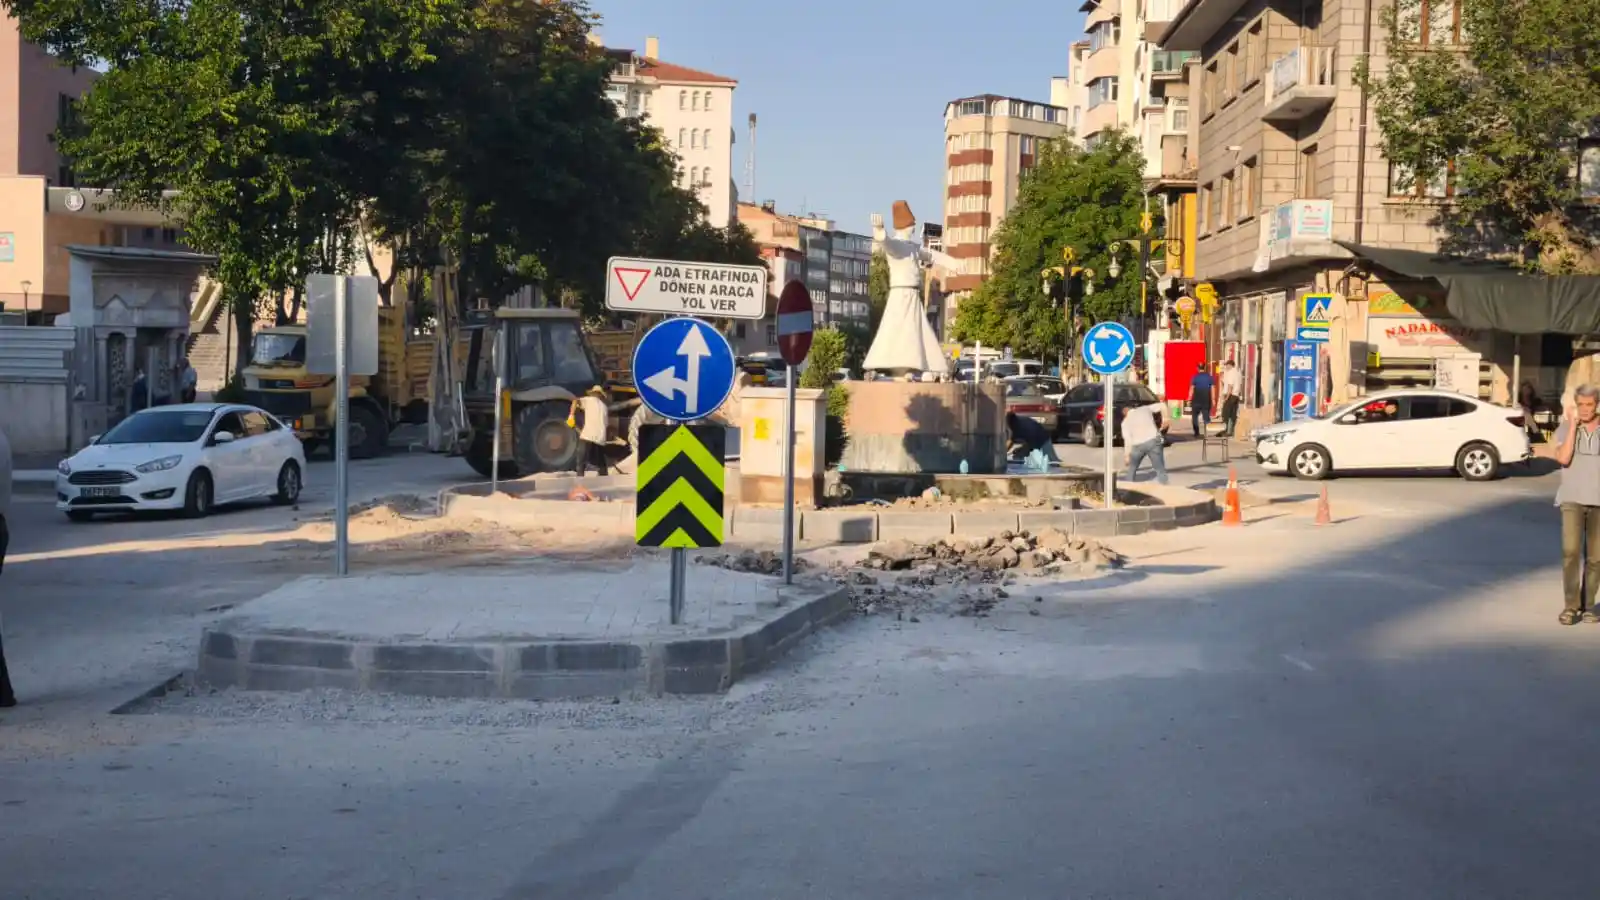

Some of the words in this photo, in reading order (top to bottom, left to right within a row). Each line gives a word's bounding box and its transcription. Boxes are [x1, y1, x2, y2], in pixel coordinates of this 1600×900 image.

[654, 266, 681, 279] ADA
[685, 268, 759, 284] ETRAFINDA
[659, 279, 706, 295] DÖNEN
[710, 284, 754, 298] ARACA
[681, 297, 706, 309] YOL
[710, 299, 737, 312] VER
